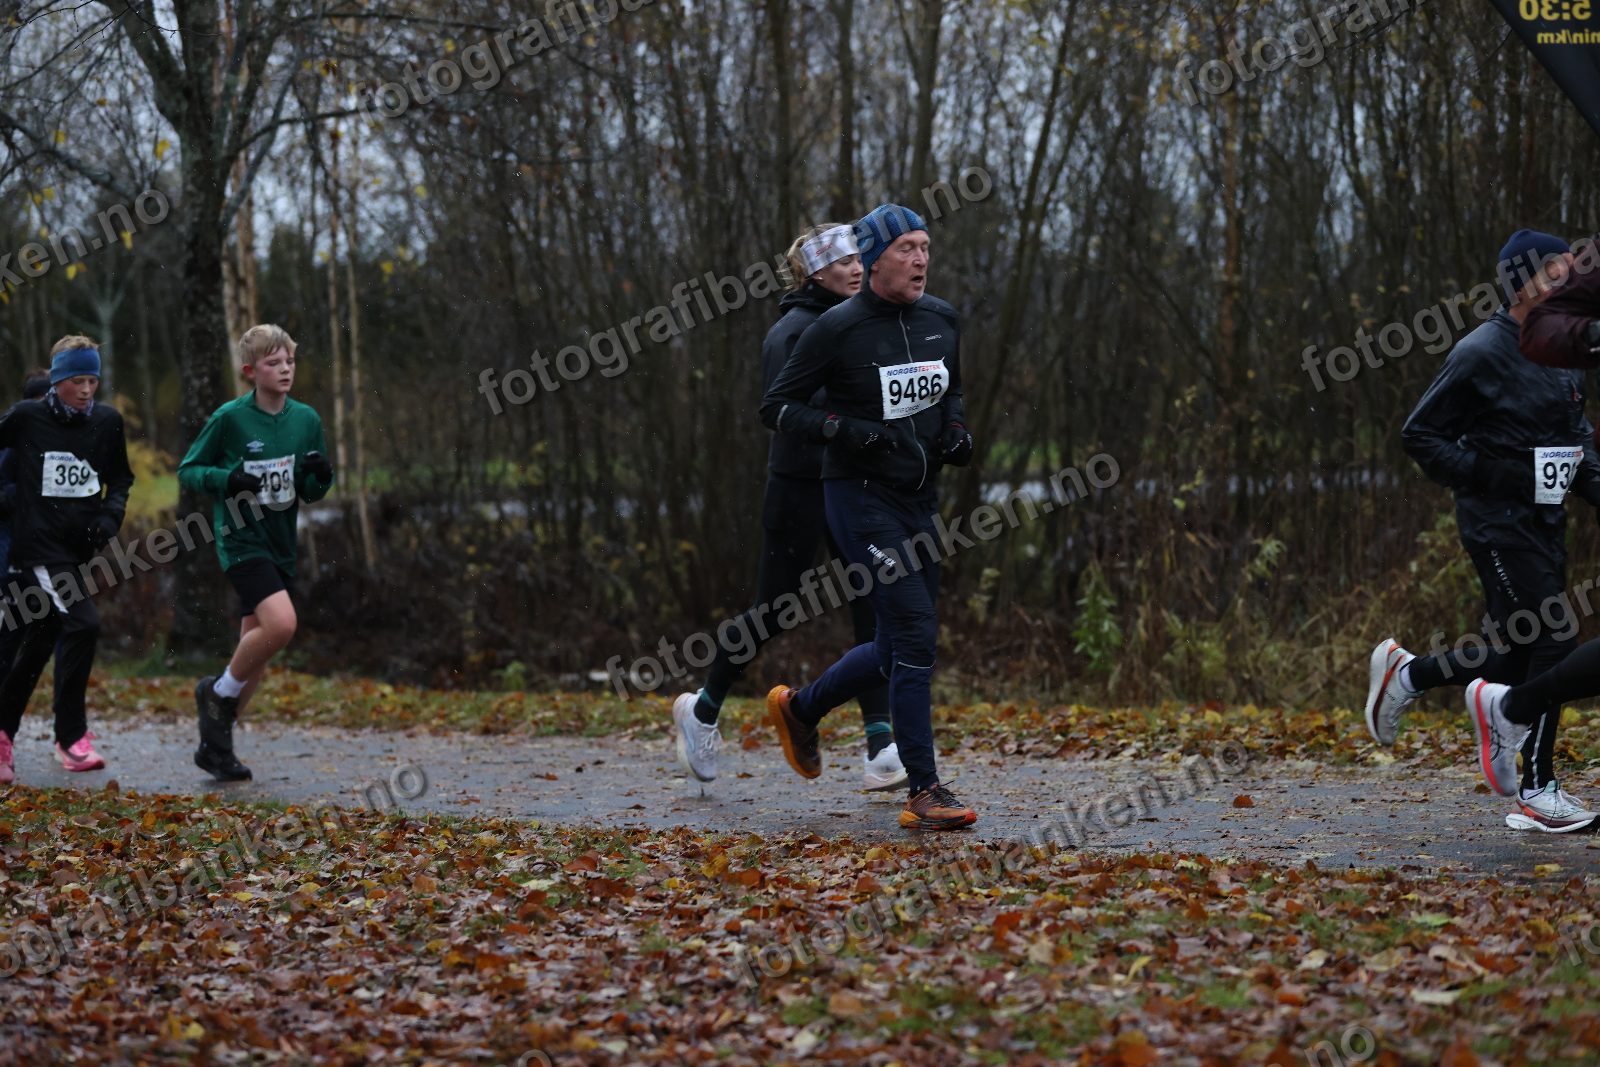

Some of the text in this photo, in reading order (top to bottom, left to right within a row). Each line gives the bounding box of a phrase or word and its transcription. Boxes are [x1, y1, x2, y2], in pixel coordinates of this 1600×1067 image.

[889, 374, 943, 406] 9486
[55, 464, 91, 486] 369
[259, 469, 290, 492] 409
[1543, 462, 1577, 490] 93
